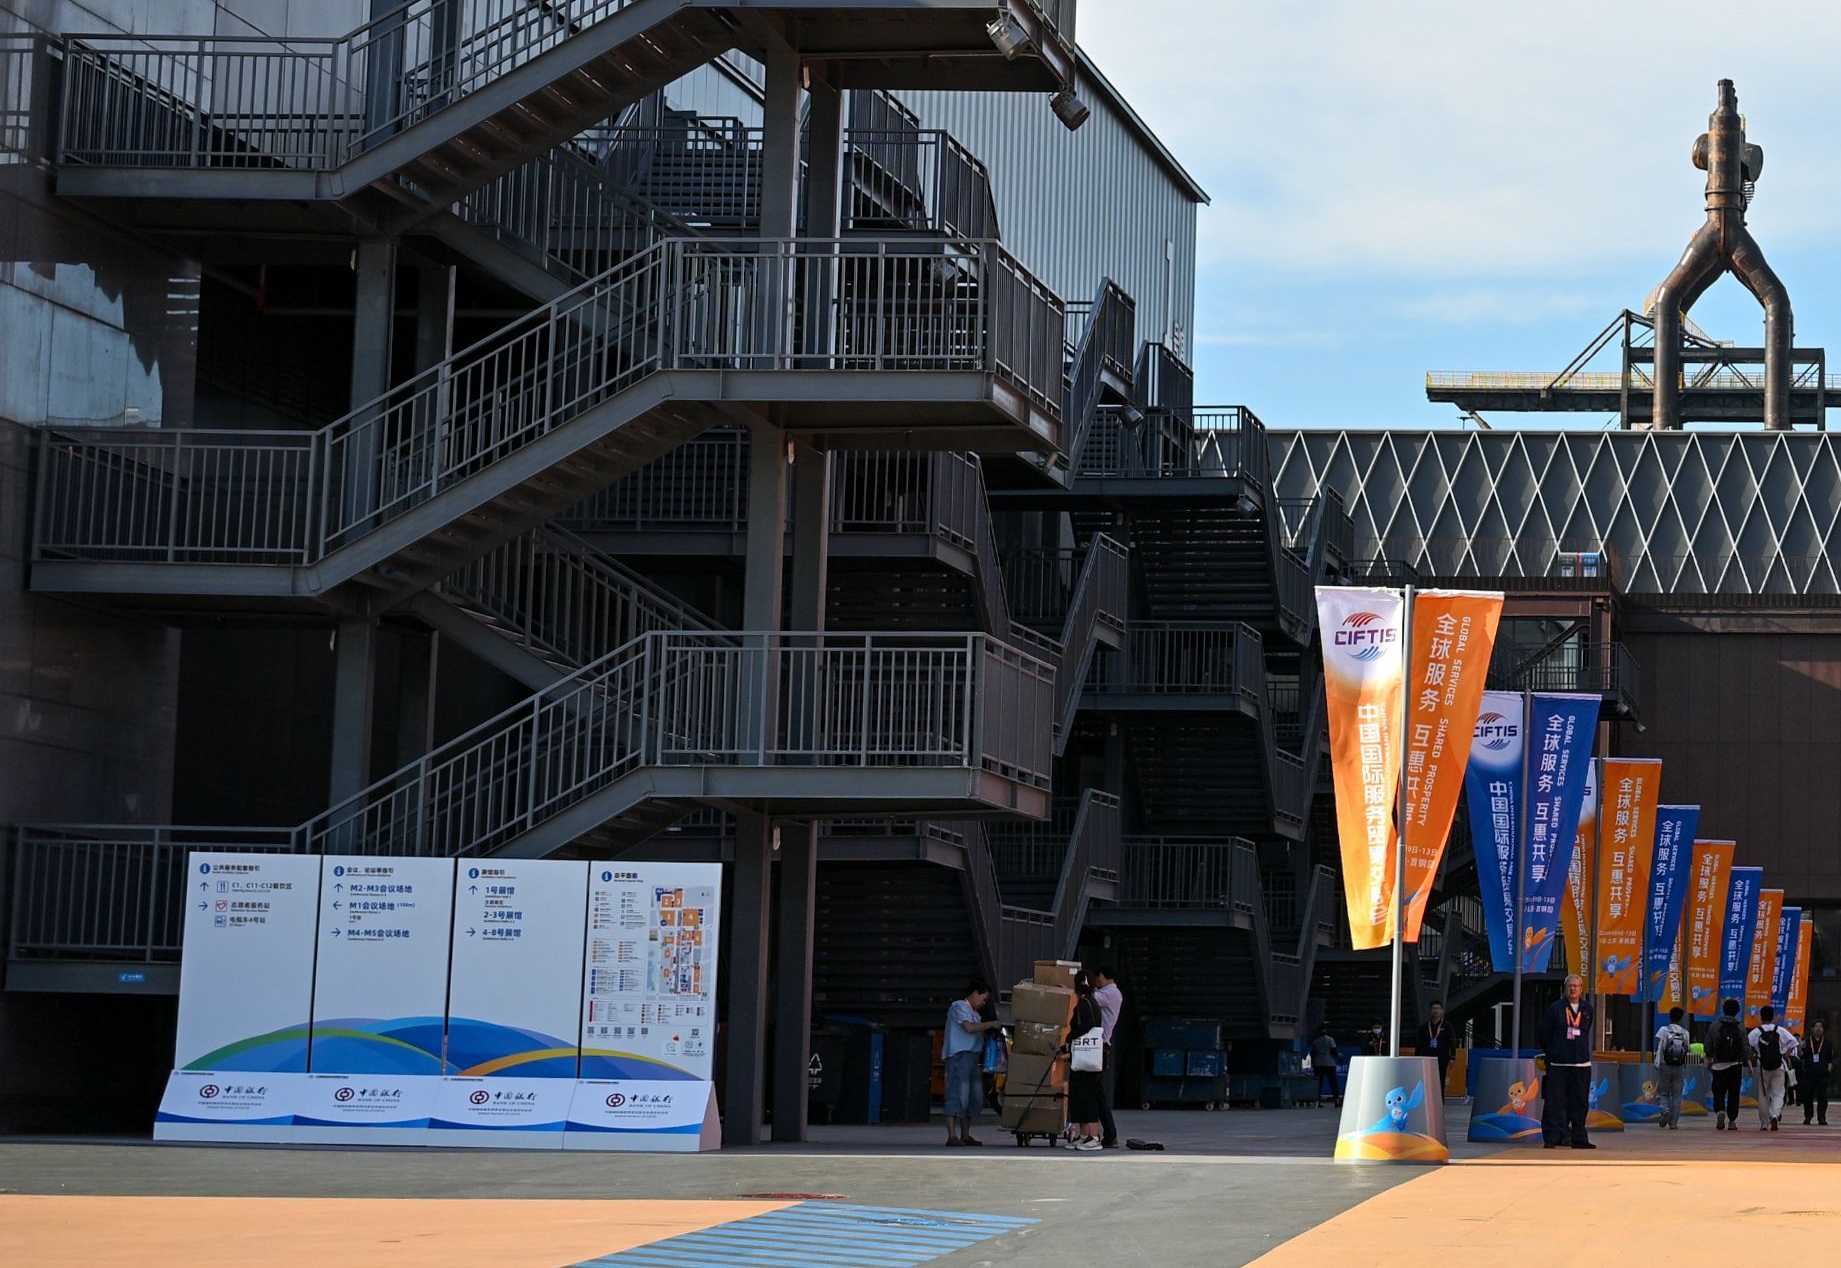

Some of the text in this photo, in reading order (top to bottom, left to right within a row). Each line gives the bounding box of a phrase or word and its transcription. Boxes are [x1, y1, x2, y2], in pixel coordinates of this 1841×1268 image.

[1334, 628, 1397, 646] CIFTIS
[1418, 612, 1458, 713] 全球服务
[1418, 615, 1472, 827] GLOBAL SERVICES SHARED PROSPERITY
[1537, 713, 1565, 794] 全球服务
[1551, 714, 1576, 828] GLOBAL SERVICES SHARED
[1613, 777, 1634, 844] 全球服务
[1531, 801, 1549, 883] 互惠共享
[1655, 820, 1674, 877] 全球服务
[350, 884, 413, 893] M2-M3会议场地
[486, 886, 515, 895] 1号展馆
[1609, 851, 1625, 919] 互惠共享
[1696, 853, 1713, 903] 全球服务
[1730, 879, 1744, 924] 全球服务
[349, 902, 395, 910] M1会议场地
[483, 911, 523, 920] 2-3号展馆
[347, 929, 410, 938] M4-M5会议场地
[482, 929, 522, 937] 4-8号展馆
